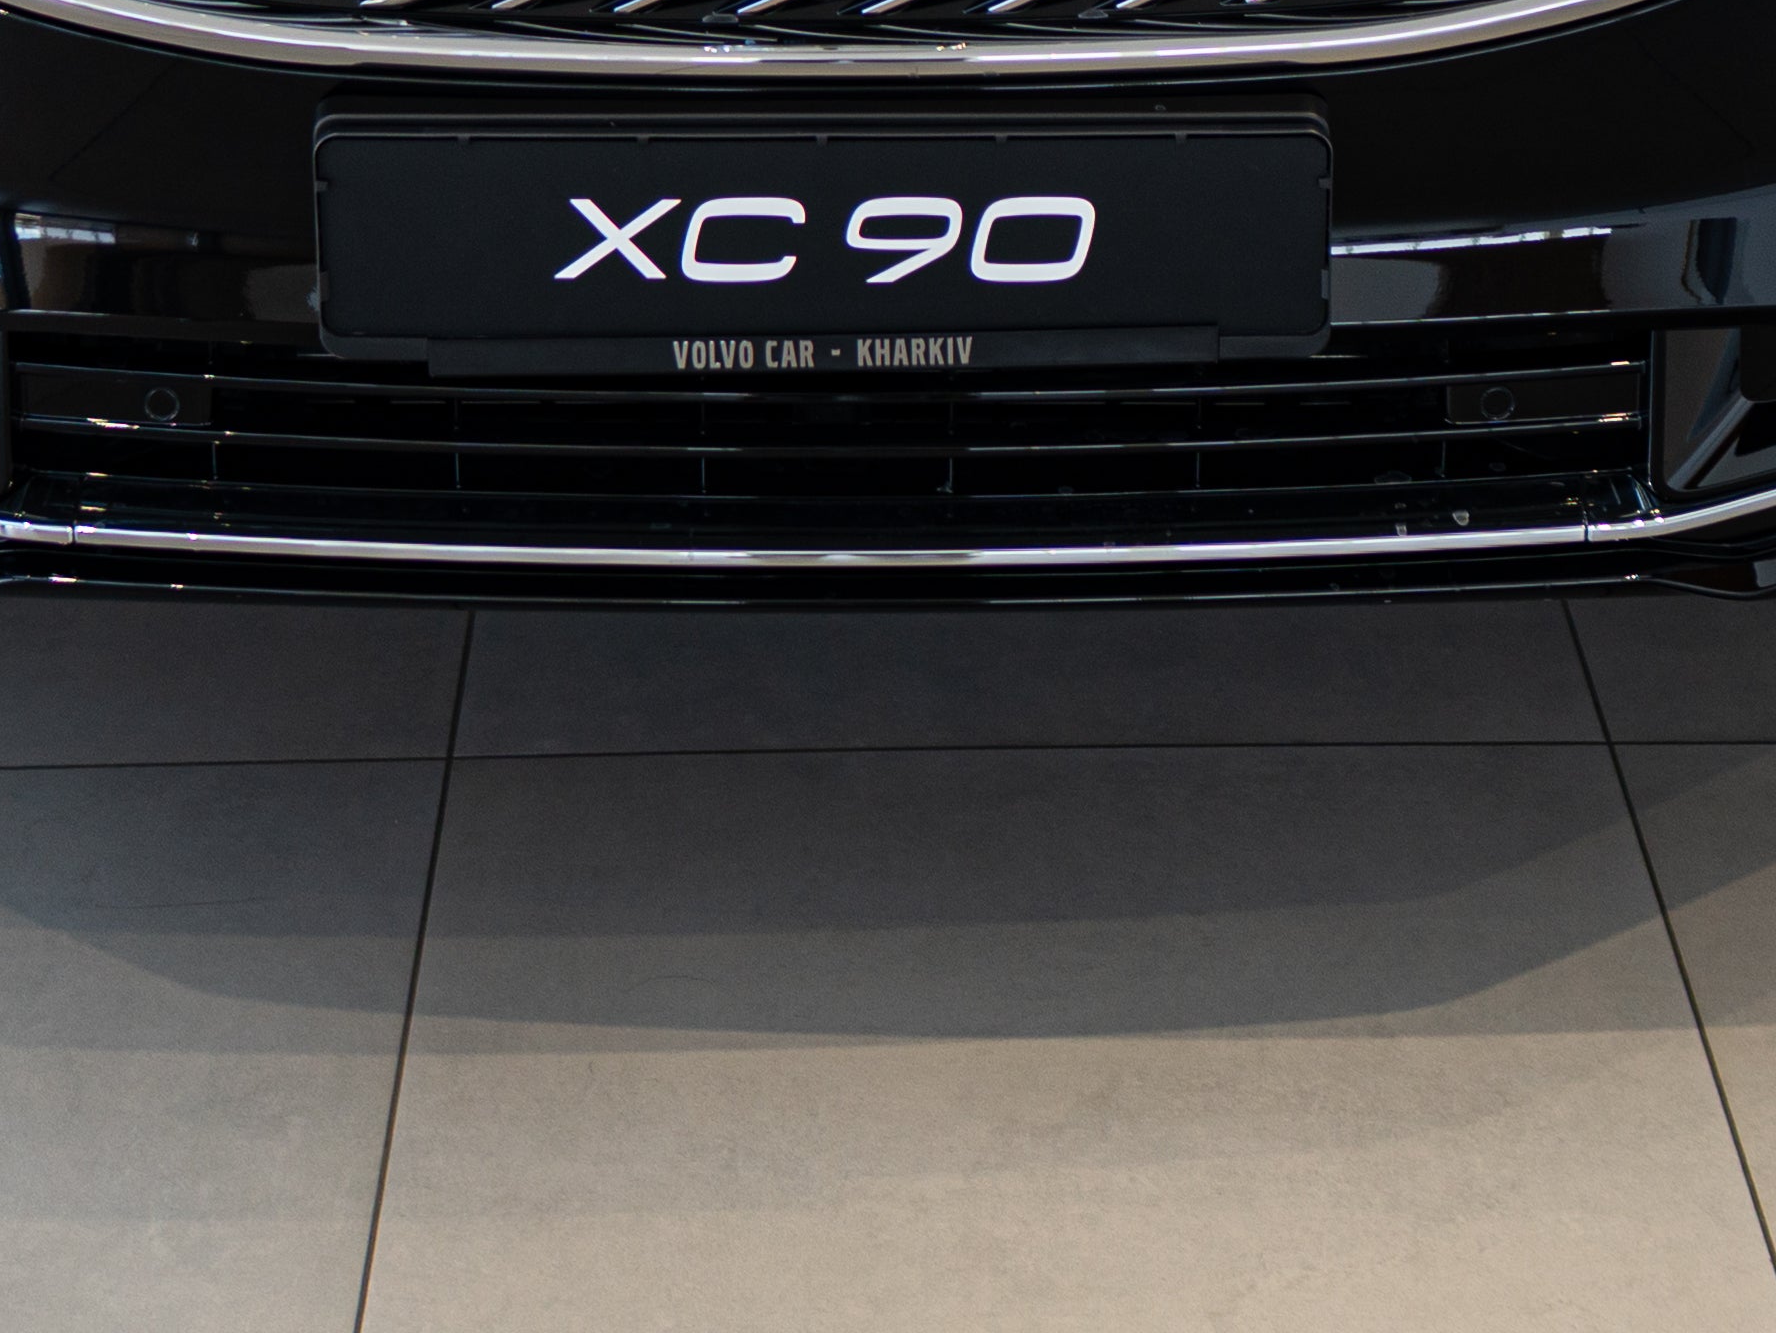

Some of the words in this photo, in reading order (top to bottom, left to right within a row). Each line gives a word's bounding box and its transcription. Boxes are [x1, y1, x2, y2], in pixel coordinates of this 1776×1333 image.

[553, 196, 806, 283] XC
[845, 196, 1096, 284] 90
[672, 339, 754, 370] VOLVO
[764, 339, 815, 368] CAR
[856, 336, 973, 367] KHARKIV
